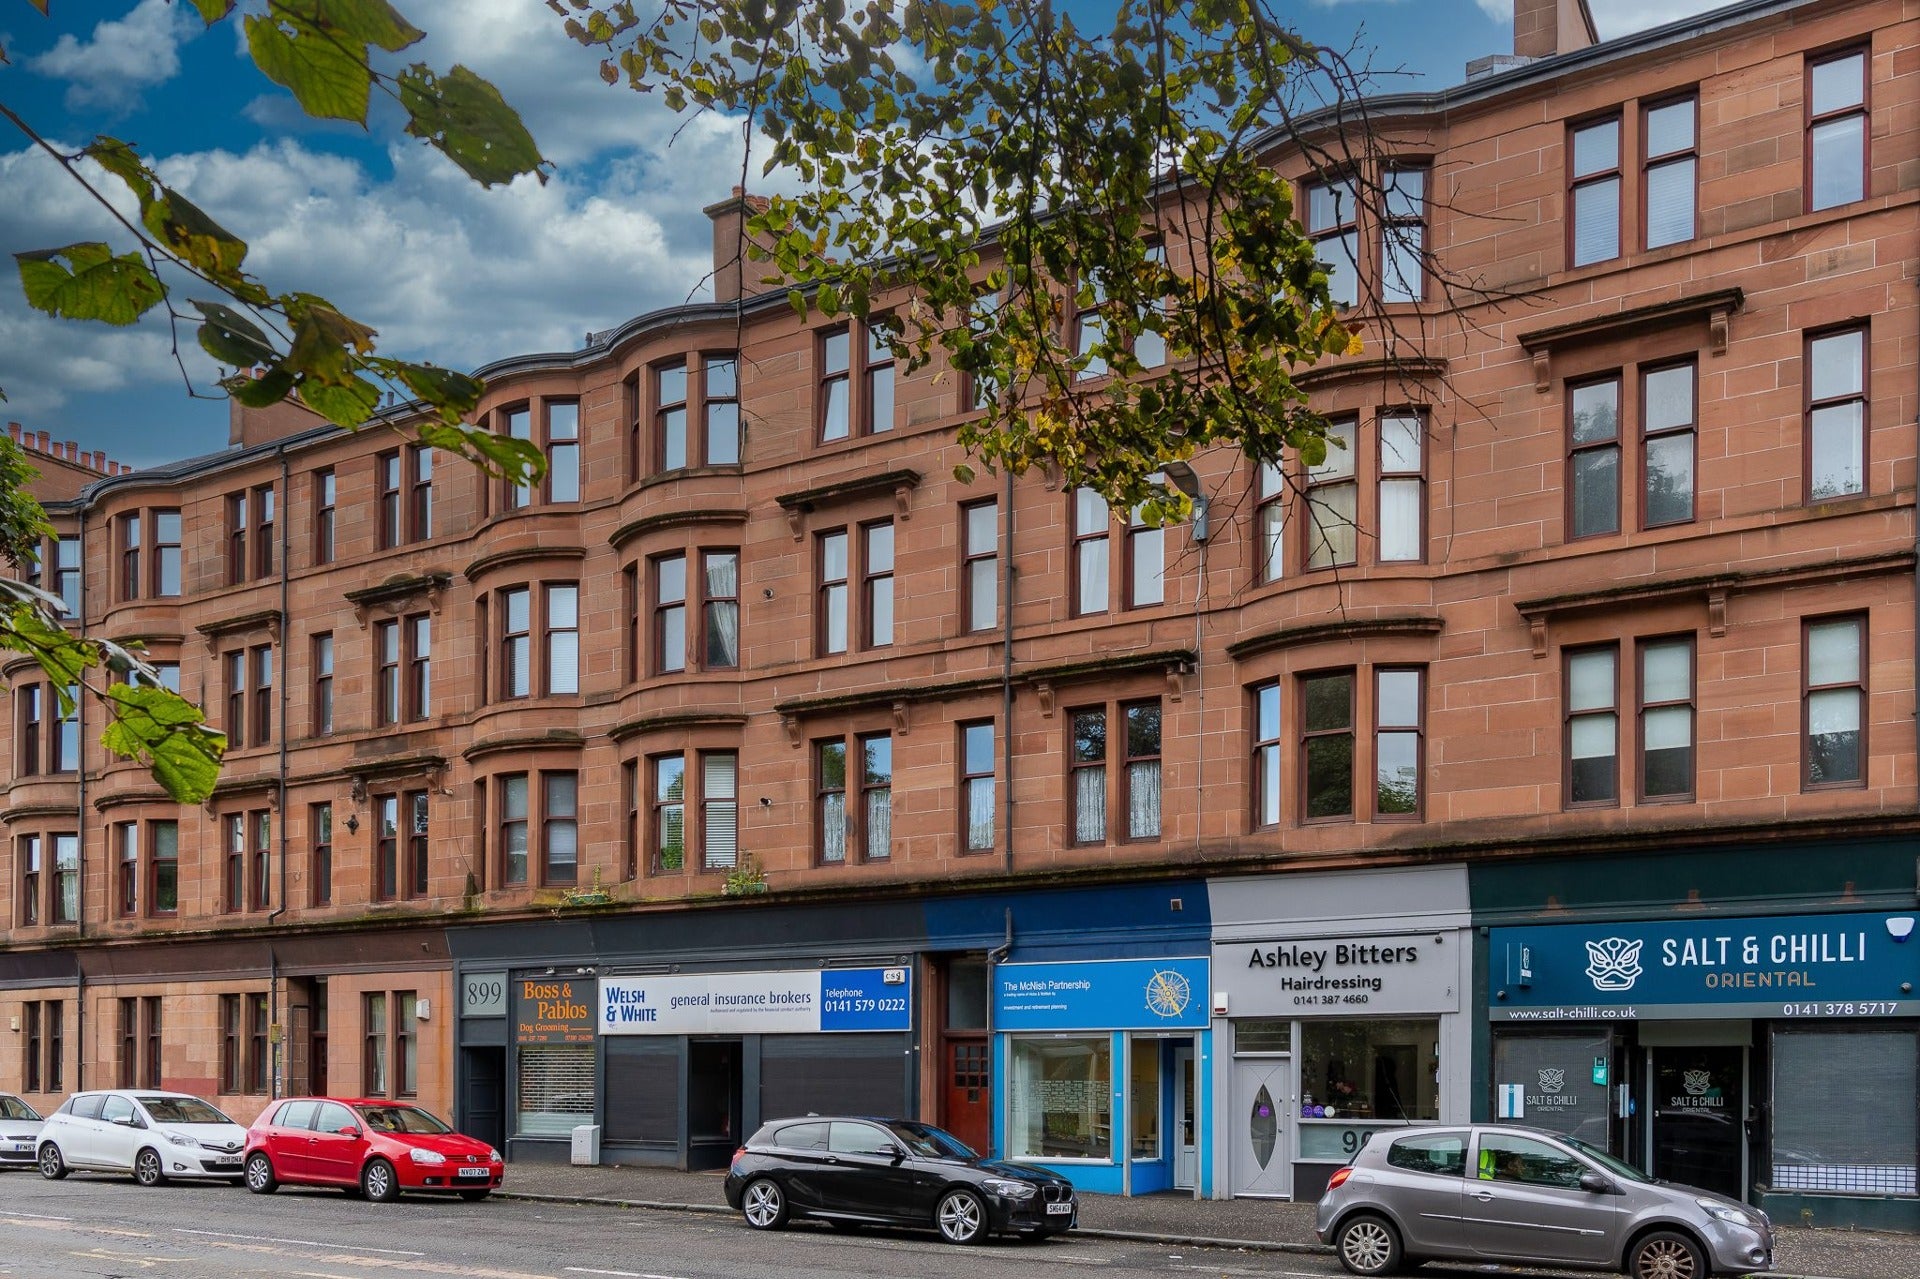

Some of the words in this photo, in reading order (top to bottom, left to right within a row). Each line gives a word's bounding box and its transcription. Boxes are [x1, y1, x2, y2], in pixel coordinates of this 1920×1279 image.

[1662, 937, 1732, 967] SALT
[1742, 936, 1760, 965] &
[1770, 932, 1866, 964] CHILLI
[1249, 944, 1327, 973] Ashley
[1335, 943, 1419, 966] Bitters
[1003, 982, 1018, 991] The
[1019, 981, 1047, 991] McNish
[1048, 979, 1091, 991] Partnership
[1281, 975, 1383, 992] Hairdressing
[1705, 971, 1817, 989] ORIENTAL
[467, 982, 502, 1005] 899
[524, 981, 559, 999] Boss
[561, 982, 573, 998] &
[825, 988, 864, 999] Telephone
[670, 993, 710, 1010] general
[714, 992, 766, 1005] insurance
[769, 990, 811, 1004] brokers
[825, 1000, 851, 1012] 0141
[855, 1000, 876, 1012] 579
[878, 999, 906, 1011] 0222
[1293, 996, 1319, 1006] 0141
[1321, 995, 1341, 1005] 387
[1343, 994, 1369, 1004] 4660
[537, 1000, 589, 1020] Pablos
[605, 1005, 617, 1022] &
[1509, 1006, 1636, 1019] www.salt-chilli.co.uk
[1783, 1003, 1819, 1016] 0141
[1825, 1003, 1854, 1016] 378
[1858, 1002, 1898, 1015] 5717
[520, 1023, 534, 1033] Dog
[535, 1023, 569, 1032] Grooming
[1526, 1095, 1546, 1106] SALT
[1546, 1095, 1553, 1105] &
[1553, 1095, 1577, 1106] CHILLI
[1671, 1096, 1690, 1107] SALT
[1692, 1096, 1698, 1107] &
[1699, 1096, 1724, 1107] CHILLI
